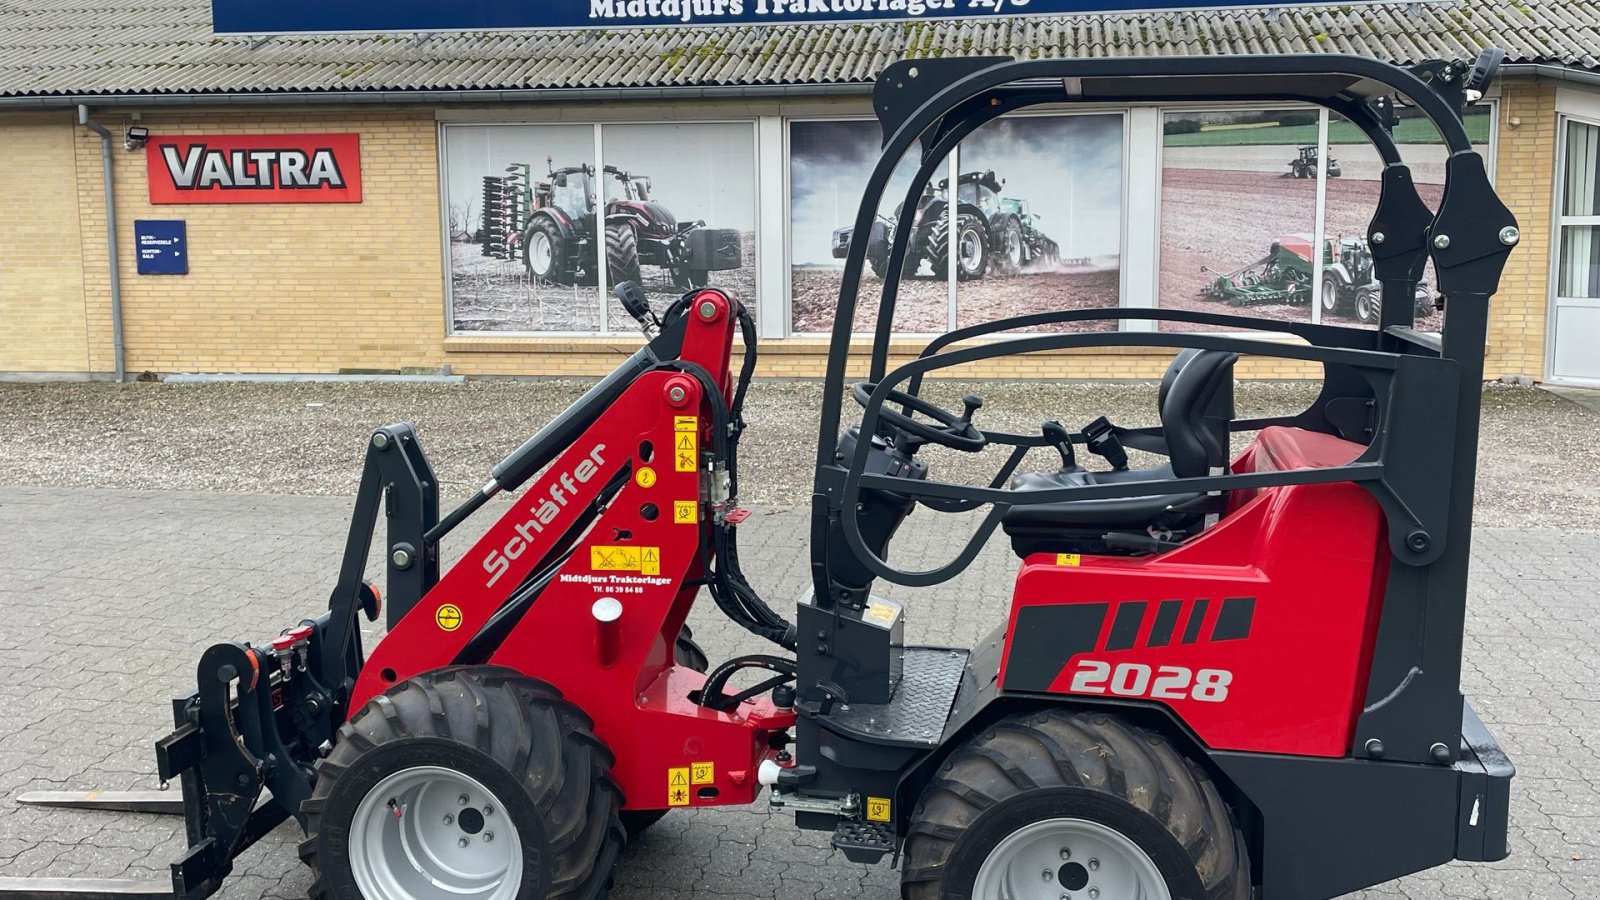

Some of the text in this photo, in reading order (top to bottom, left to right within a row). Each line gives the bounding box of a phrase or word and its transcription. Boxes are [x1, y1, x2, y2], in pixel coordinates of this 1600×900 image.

[588, 0, 744, 22] Midtdjurs
[159, 144, 347, 190] VALTRA
[482, 443, 606, 588] Schäffer
[560, 574, 672, 585] Midtdjurs Traktorlager
[615, 586, 624, 594] 39
[624, 586, 634, 594] 84
[1070, 659, 1233, 703] 2028
